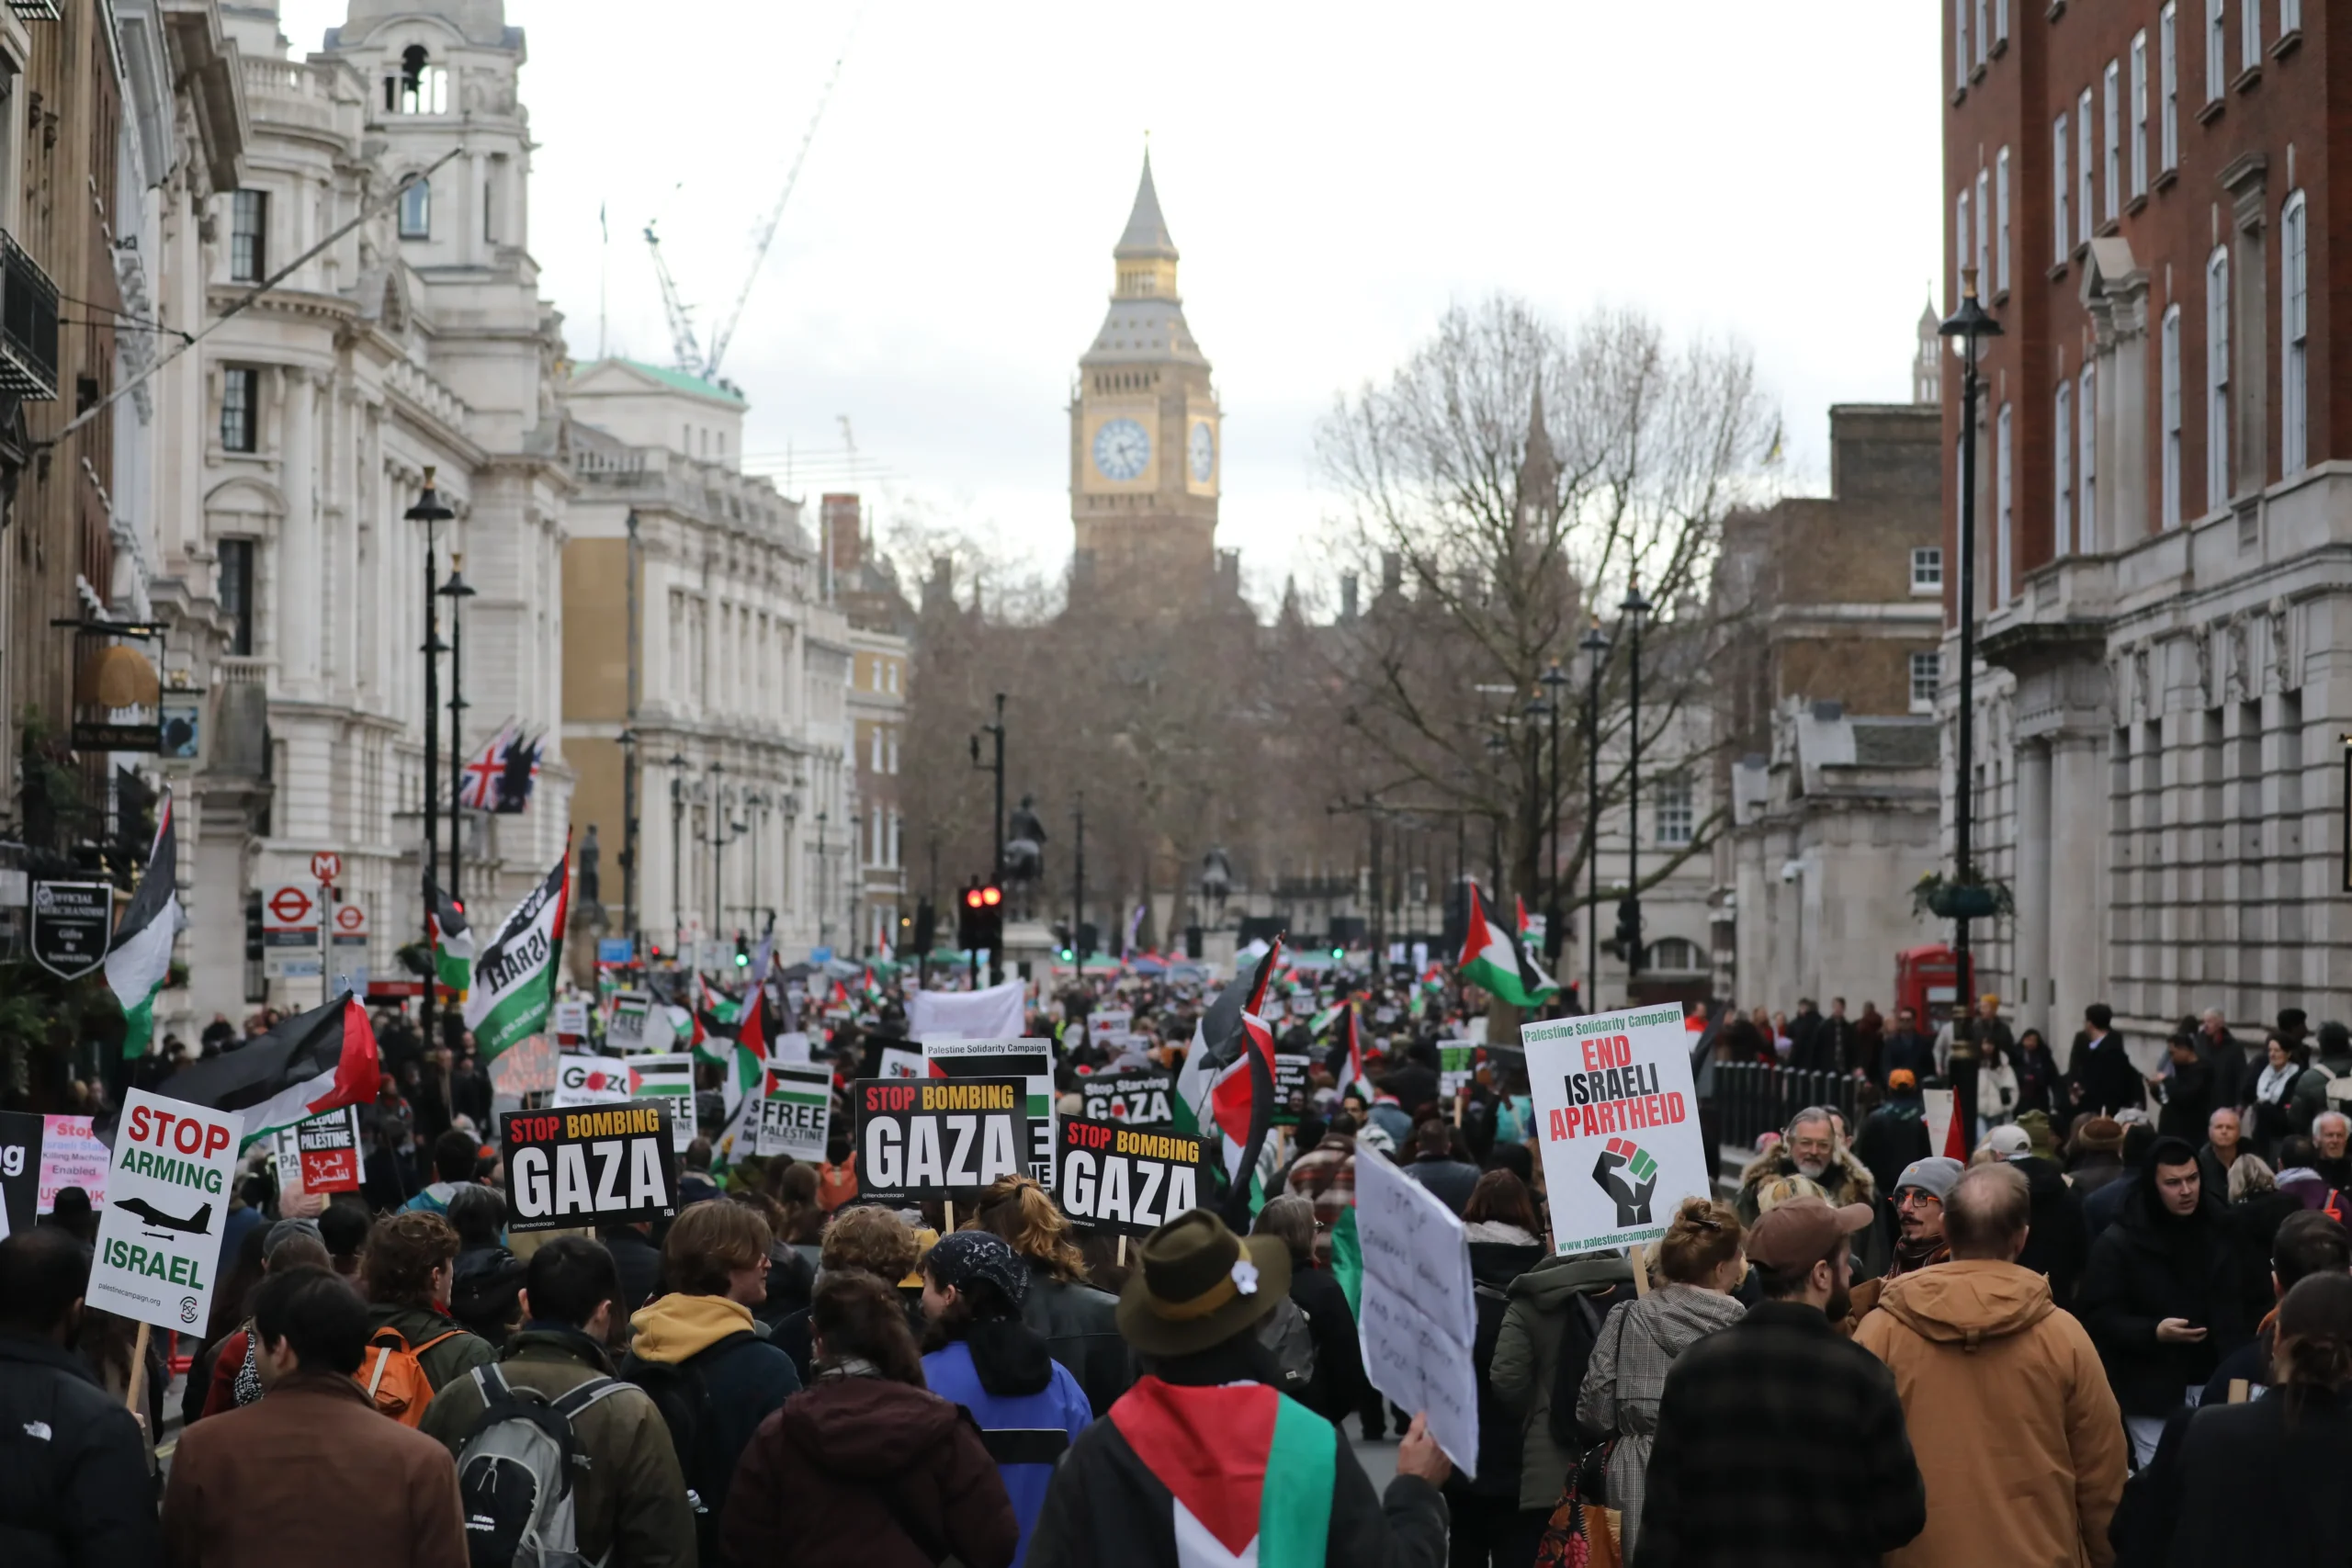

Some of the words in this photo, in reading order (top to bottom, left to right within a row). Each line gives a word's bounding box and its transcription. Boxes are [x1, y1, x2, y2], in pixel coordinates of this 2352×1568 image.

[315, 856, 336, 876] M
[1523, 1023, 1574, 1043] Palestine
[1576, 1017, 1625, 1035] Solidarity
[1628, 1010, 1681, 1028] Campaign
[928, 1045, 966, 1055] Palestine
[967, 1044, 1005, 1054] Solidarity
[1007, 1043, 1046, 1053] Campaign
[1580, 1034, 1632, 1072] END
[865, 1086, 915, 1111] STOP
[922, 1085, 1014, 1111] BOMBING
[1084, 1083, 1114, 1096] Stop
[1116, 1077, 1170, 1093] Starving
[1564, 1062, 1659, 1106] ISRAELI
[763, 1100, 826, 1131] FREE
[1086, 1091, 1173, 1124] GAZA
[1549, 1091, 1687, 1142] APARTHEID
[128, 1105, 231, 1160] STOP
[300, 1131, 351, 1150] PALESTINE
[510, 1115, 560, 1144] STOP
[566, 1108, 660, 1139] BOMBING
[761, 1125, 824, 1143] PALESTINE
[42, 1152, 70, 1162] Killing
[72, 1153, 107, 1163] Machine
[865, 1114, 1018, 1189] GAZA
[1067, 1122, 1112, 1150] STOP
[1116, 1130, 1200, 1163] BOMBING
[52, 1165, 96, 1176] Enabled
[119, 1147, 223, 1195] ARMING
[309, 1153, 343, 1171] الحرية
[512, 1137, 668, 1218] GAZA
[1062, 1149, 1197, 1227] GAZA
[663, 1208, 675, 1217] FOA
[103, 1236, 204, 1291] ISRAEL
[97, 1282, 162, 1306] palestinecampaign.org
[182, 1304, 196, 1316] PSC
